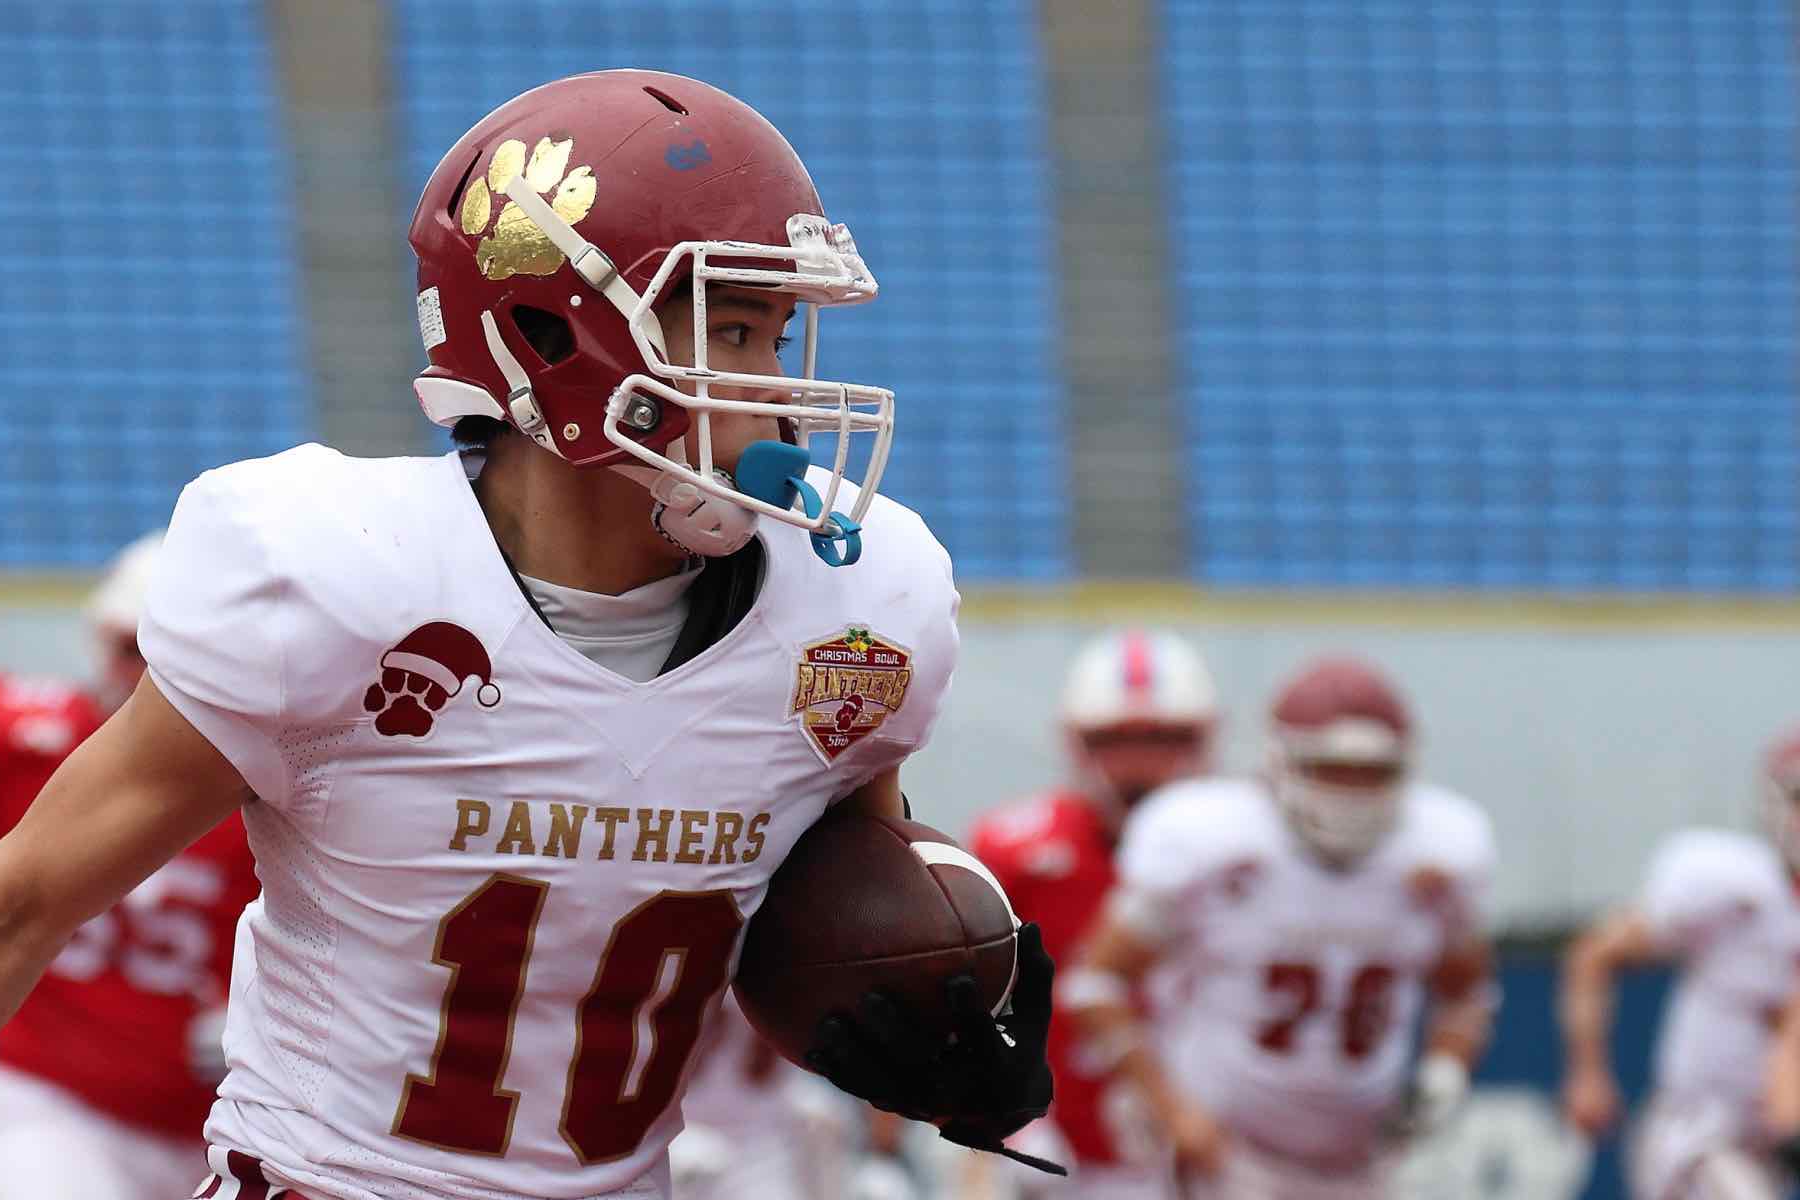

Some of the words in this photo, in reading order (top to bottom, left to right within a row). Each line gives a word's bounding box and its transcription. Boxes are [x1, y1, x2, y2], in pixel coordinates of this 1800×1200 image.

[814, 650, 867, 663] CHRISTMAS
[874, 653, 900, 665] BOWL
[793, 664, 911, 712] PANTHERS
[448, 798, 771, 865] PANTHERS
[389, 871, 744, 1168] 10
